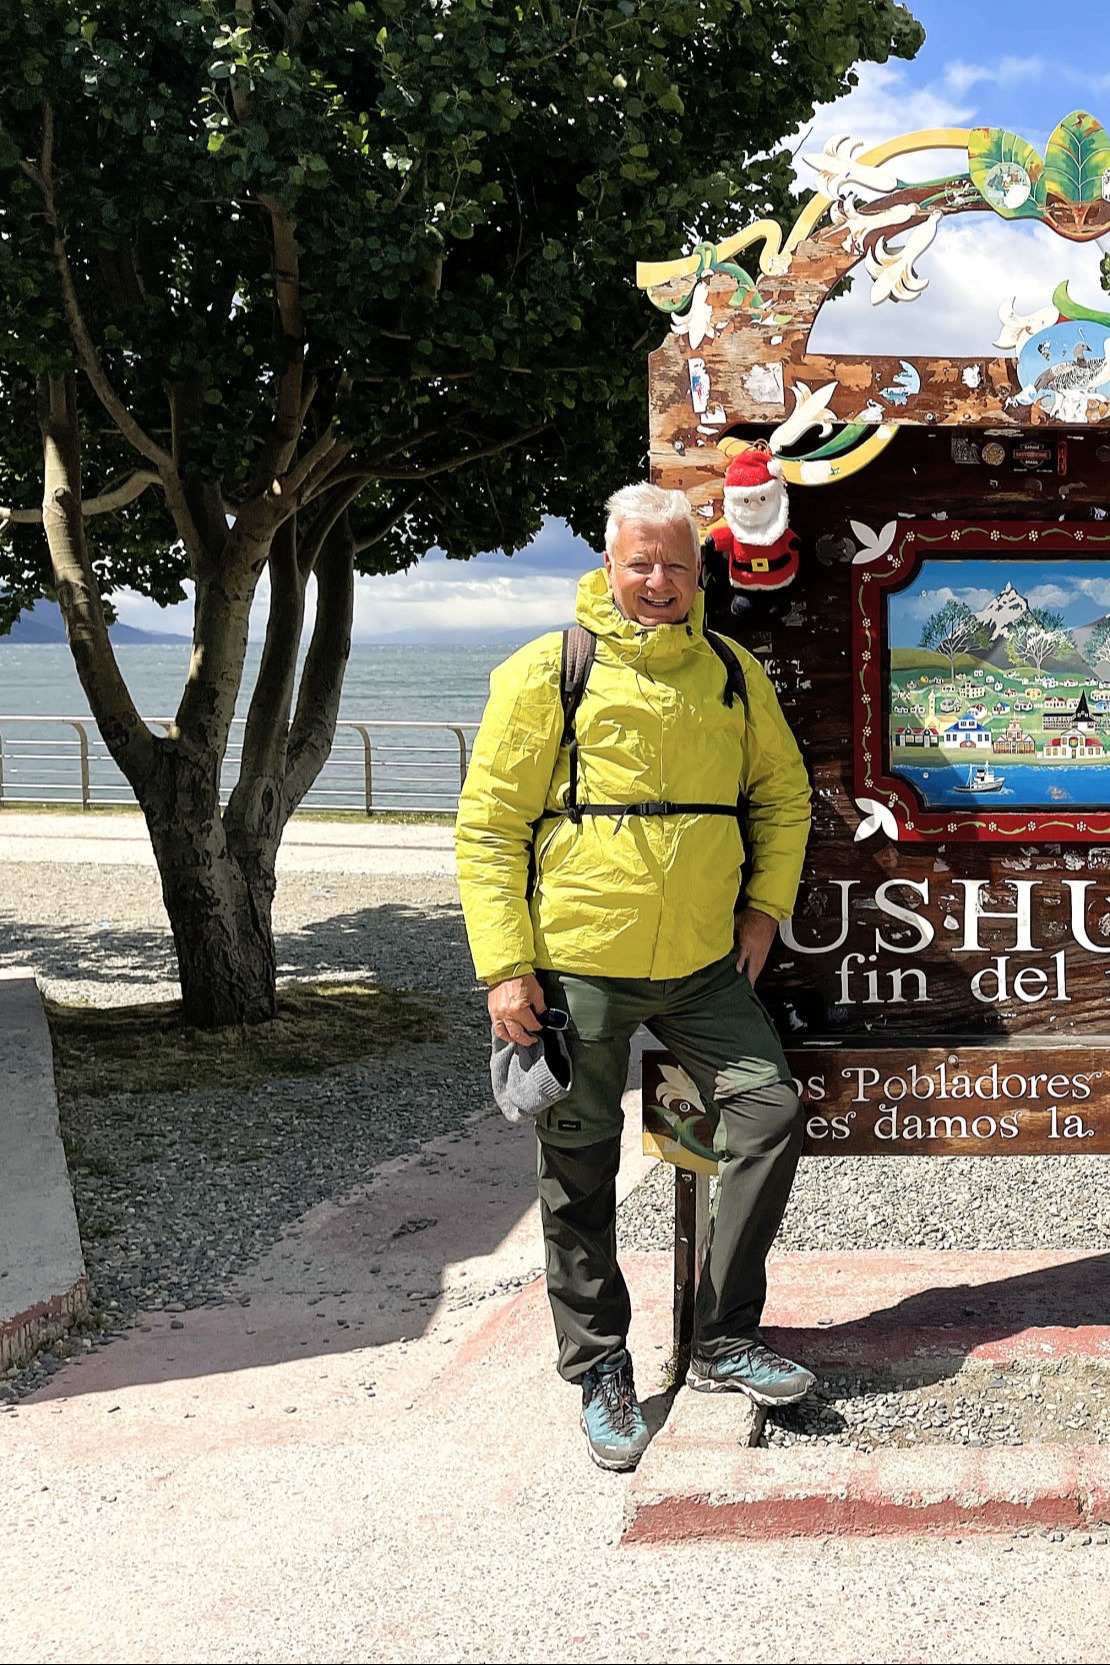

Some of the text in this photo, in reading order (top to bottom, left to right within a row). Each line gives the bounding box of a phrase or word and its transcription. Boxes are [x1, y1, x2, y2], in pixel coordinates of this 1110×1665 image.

[834, 952, 933, 1005] fin
[970, 949, 1072, 1003] del
[841, 1062, 1103, 1103] Pobladores
[805, 1110, 857, 1140] es
[873, 1102, 1024, 1141] damos
[1046, 1105, 1096, 1140] la
